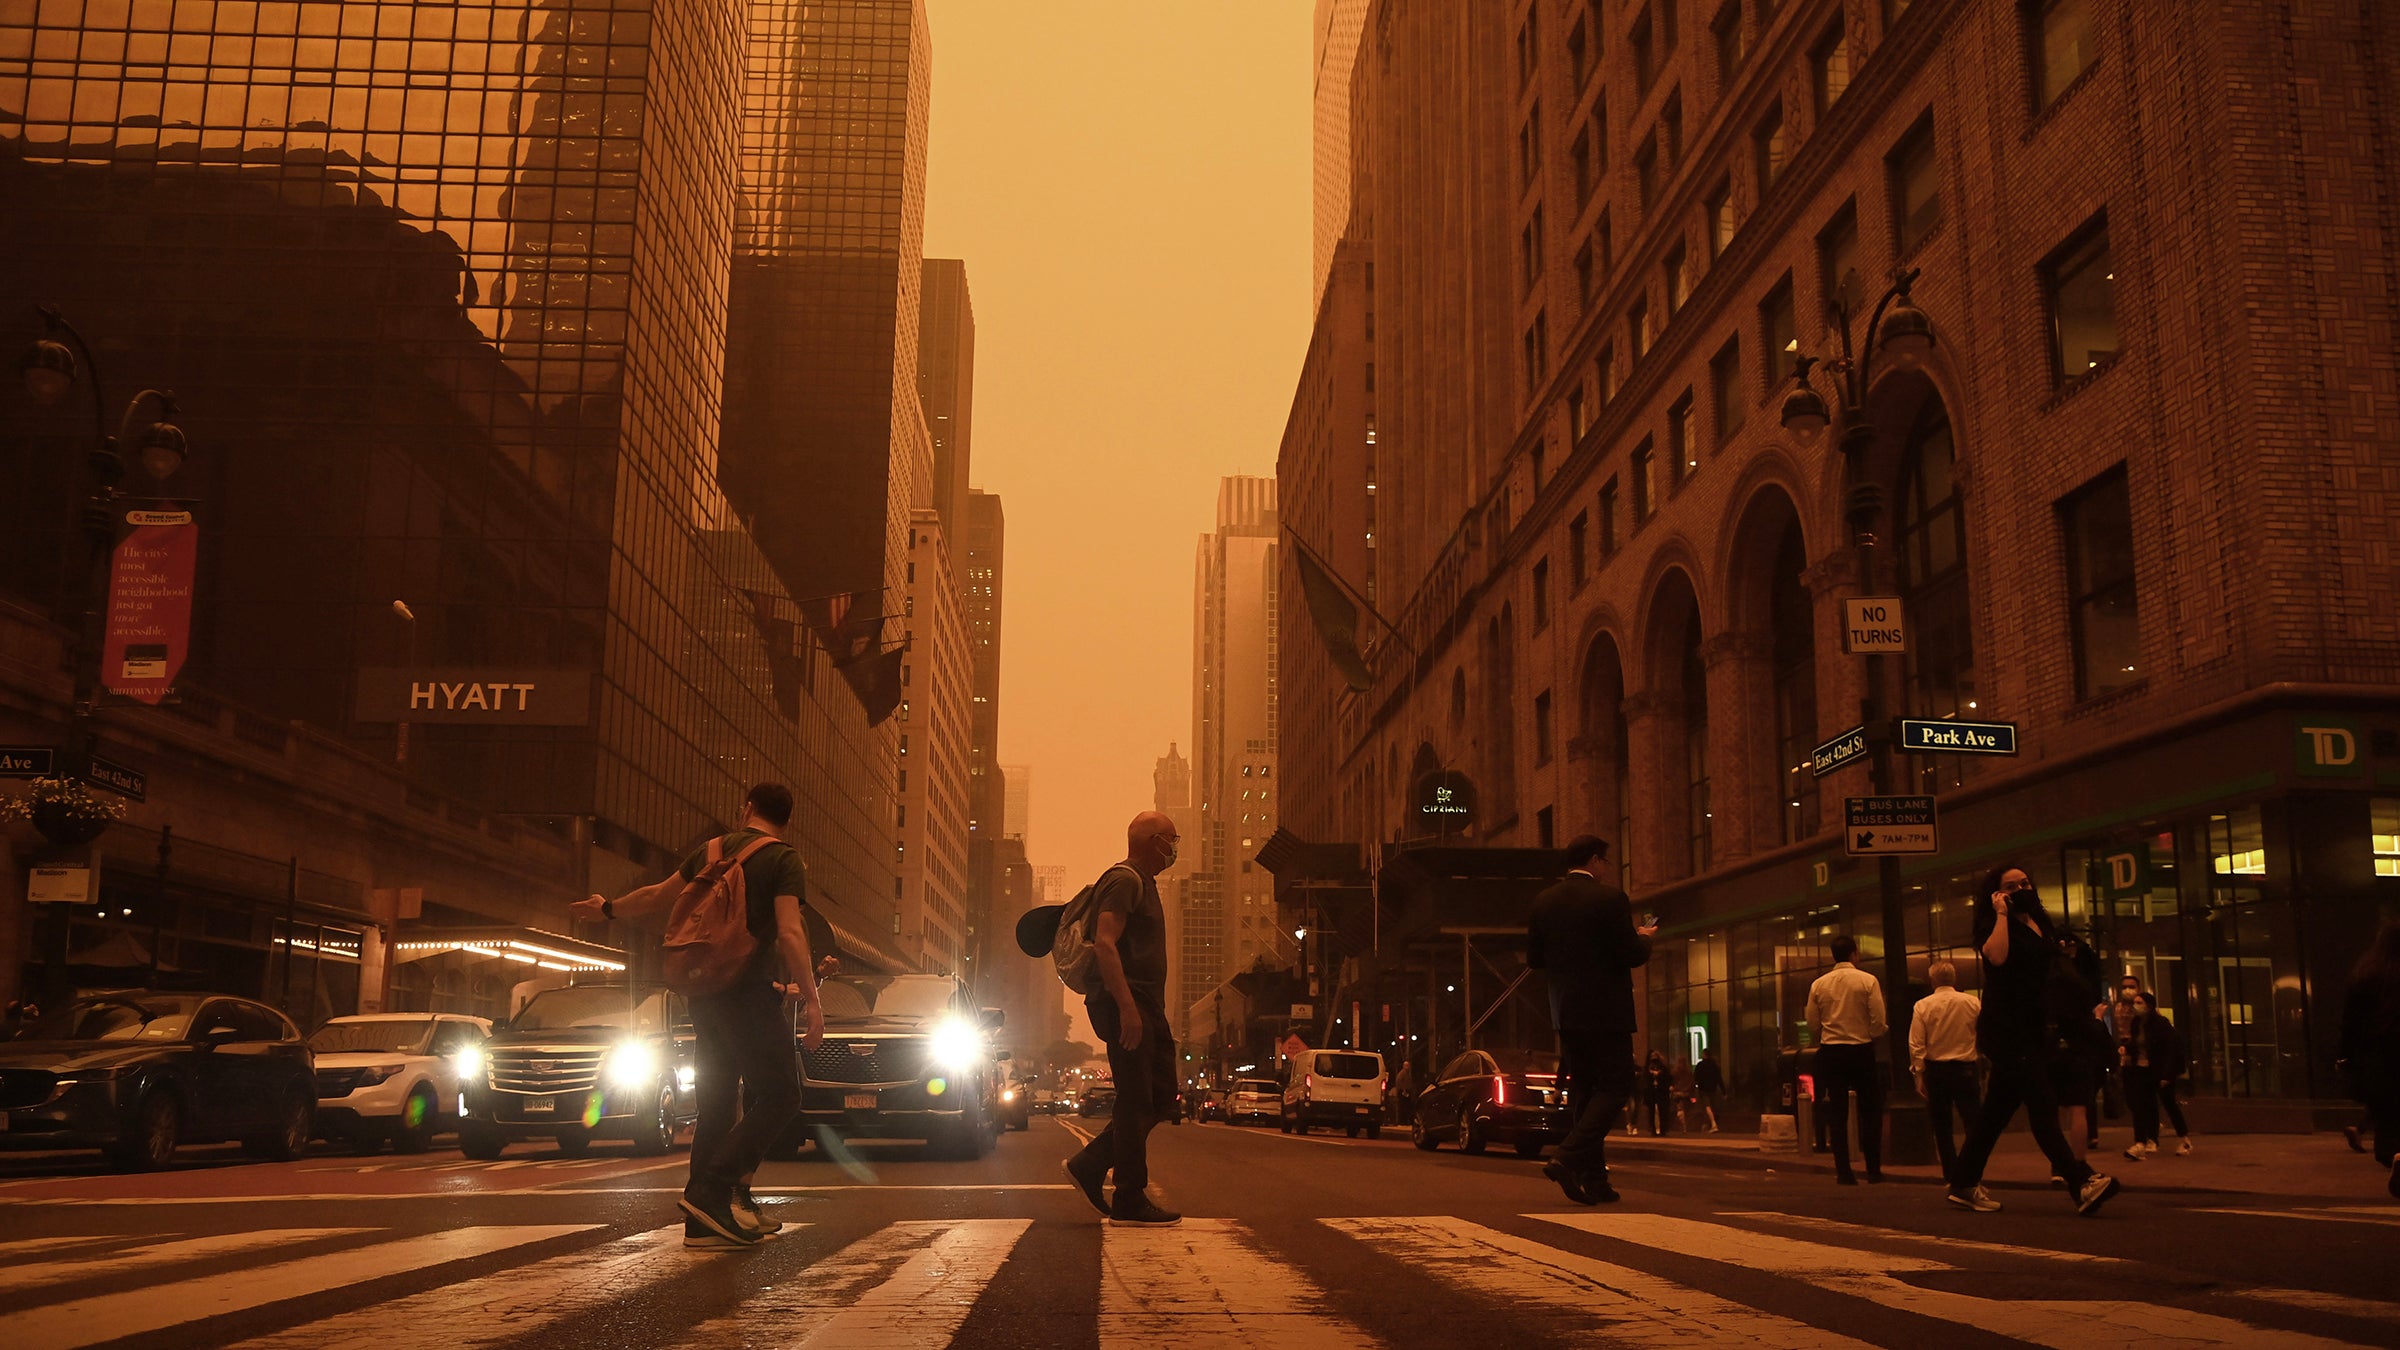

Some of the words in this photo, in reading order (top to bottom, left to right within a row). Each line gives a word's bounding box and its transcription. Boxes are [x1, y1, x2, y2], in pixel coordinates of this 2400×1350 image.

[124, 547, 142, 558] The
[120, 563, 145, 571] most
[119, 574, 169, 584] accessible
[117, 586, 188, 597] neighborhood
[115, 601, 136, 610] just
[137, 602, 153, 611] got
[1862, 606, 1886, 622] NO
[1851, 629, 1902, 644] TURNS
[410, 682, 535, 711] HYATT
[1921, 727, 1961, 745] Park
[1964, 729, 1996, 747] Ave
[1815, 751, 1833, 770] East
[1833, 739, 1854, 761] 42nd
[1853, 735, 1864, 752] St
[2301, 727, 2356, 766] TD
[0, 754, 32, 769] Ave
[91, 762, 111, 783] East
[111, 770, 132, 790] 42nd
[133, 778, 143, 793] St
[1422, 804, 1467, 813] CIPRIANI
[1869, 800, 1893, 810] BUS
[1896, 800, 1928, 809] LANE
[1852, 814, 1893, 824] BUSES
[1896, 814, 1928, 824] ONLY
[1882, 834, 1929, 844] 7AM-7PM
[1813, 861, 1828, 887] TD
[2105, 853, 2137, 889] TD
[1686, 1026, 1707, 1066] TD
